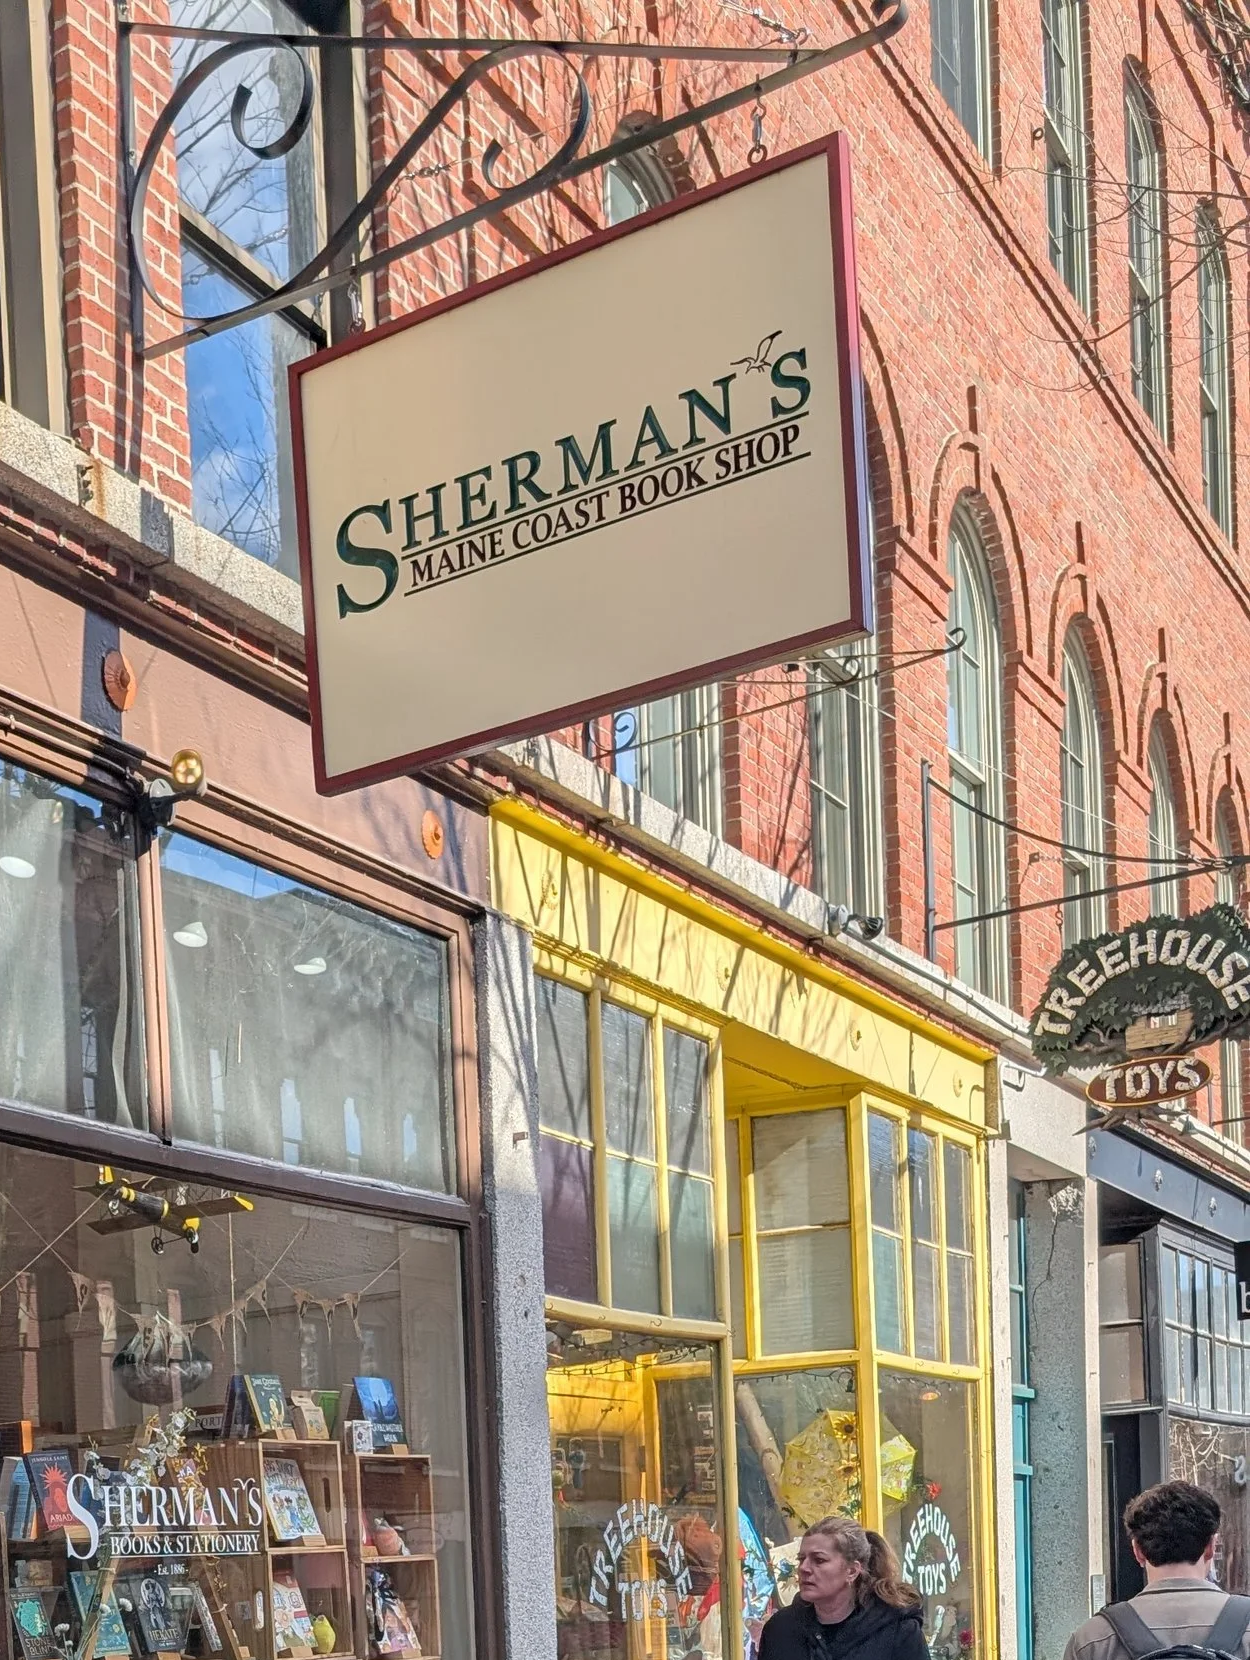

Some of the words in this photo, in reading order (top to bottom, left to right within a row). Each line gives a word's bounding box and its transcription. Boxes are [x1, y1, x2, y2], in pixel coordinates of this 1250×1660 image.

[337, 346, 812, 620] SHERMAN'S
[410, 527, 506, 589] MAINE
[511, 489, 610, 549] COAST
[618, 455, 709, 515] BOOK
[714, 423, 800, 482] SHOP
[1034, 928, 1250, 1037] TREEHOUSE
[1099, 1058, 1201, 1102] TOYS
[50, 1513, 73, 1523] ARIAD
[66, 1477, 263, 1560] SHERMAN'S
[110, 1536, 161, 1555] BOOKS
[163, 1536, 173, 1553] &
[176, 1534, 260, 1554] STATIONERY
[589, 1498, 692, 1608] TREEHOUSE
[902, 1503, 961, 1585] TREEHOUSE
[170, 1564, 185, 1575] 1886
[918, 1562, 947, 1596] TOYS
[618, 1579, 668, 1622] TOYS
[26, 1637, 51, 1647] STONE
